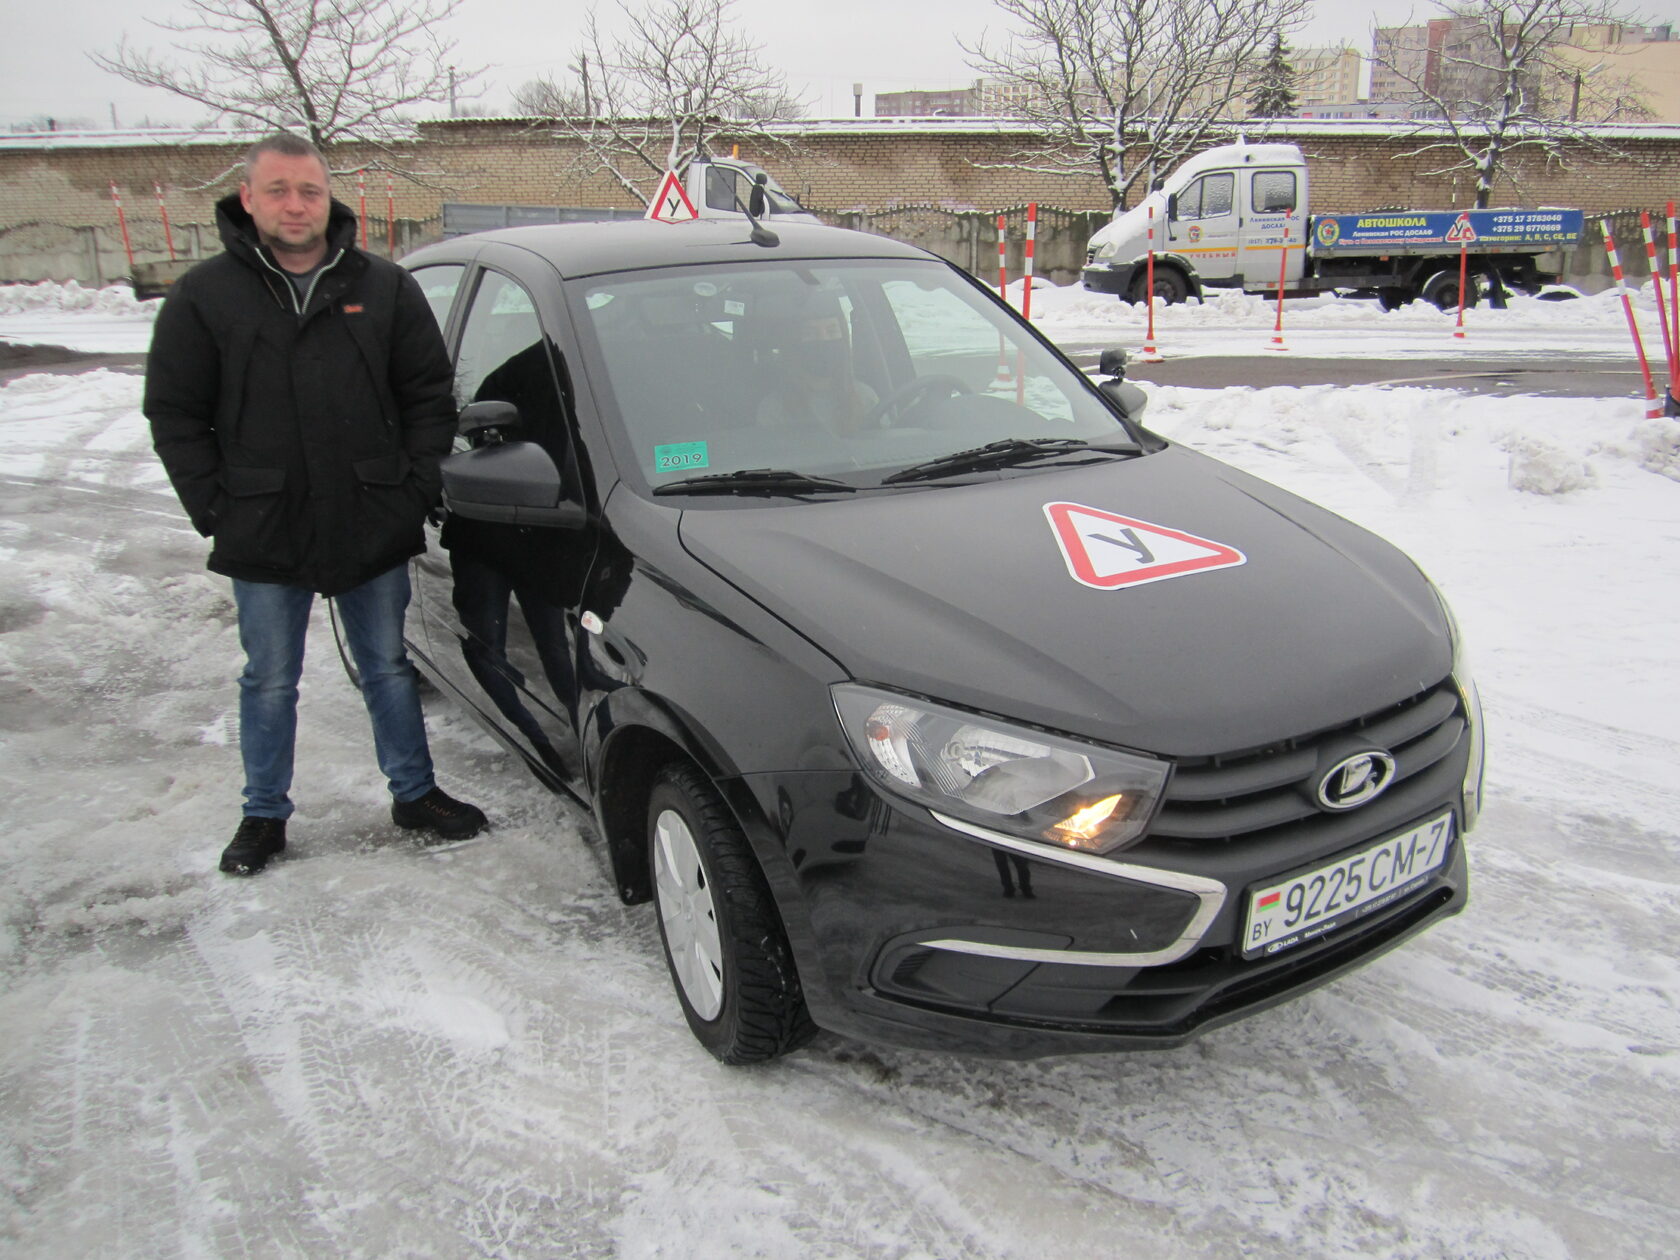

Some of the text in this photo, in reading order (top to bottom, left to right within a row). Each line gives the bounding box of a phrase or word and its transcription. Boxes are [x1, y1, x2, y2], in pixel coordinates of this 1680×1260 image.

[1357, 218, 1426, 228] АВТОШКОЛА
[661, 453, 703, 467] 2019
[1252, 918, 1272, 941] BY
